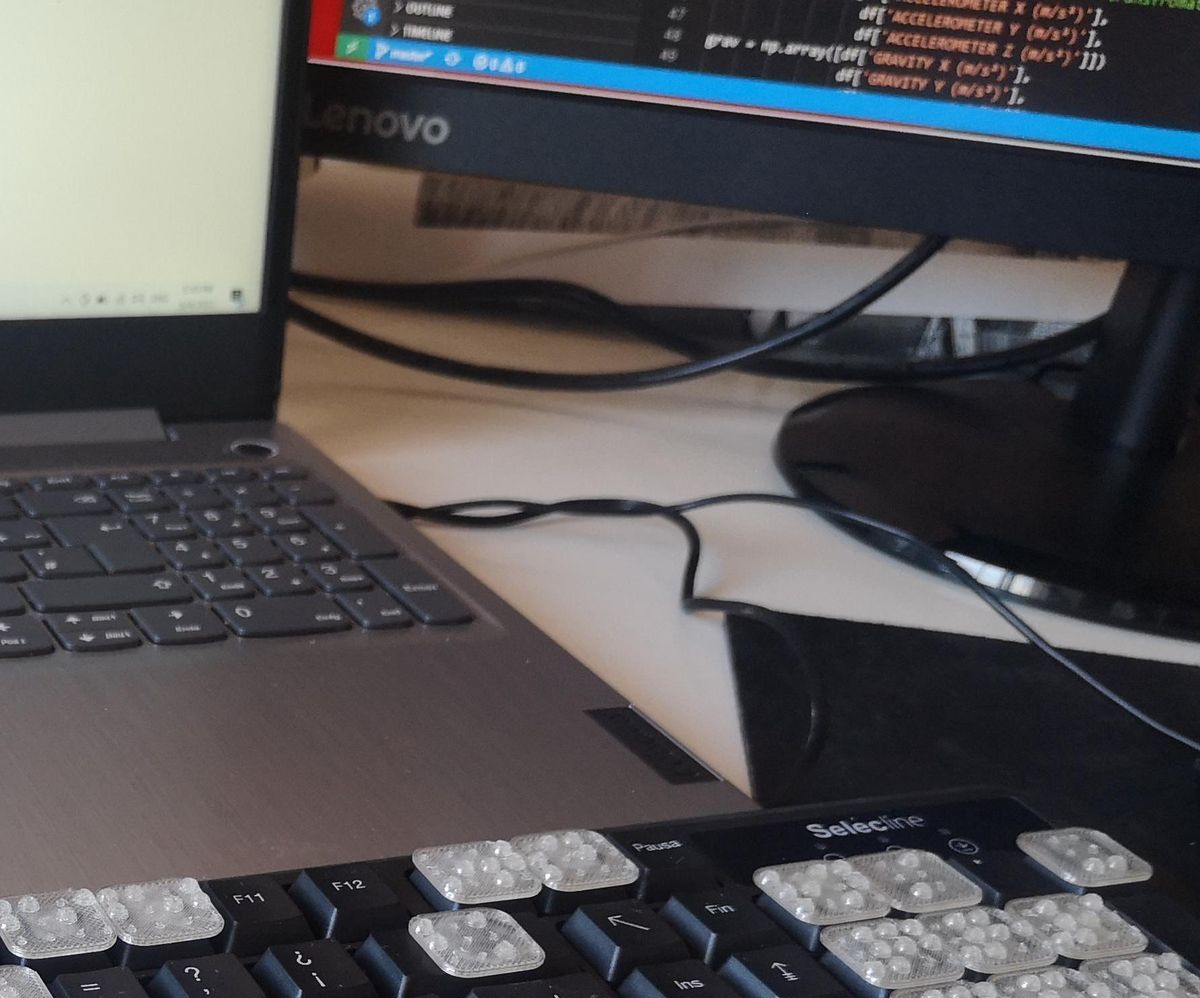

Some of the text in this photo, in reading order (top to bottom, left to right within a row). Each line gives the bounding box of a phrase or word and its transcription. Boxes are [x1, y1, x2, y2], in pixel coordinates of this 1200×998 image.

[405, 1, 455, 19] OUTLINE
[403, 23, 454, 43] TIMELINE
[1009, 23, 1020, 36] Y
[704, 33, 740, 51] grav
[939, 58, 951, 72] X
[934, 80, 946, 93] Y
[806, 815, 927, 839] Selecline
[632, 839, 683, 854] Pausa
[331, 879, 366, 892] F12
[233, 892, 265, 905] F11
[705, 902, 734, 916] Fin
[184, 966, 201, 982] ?
[673, 976, 704, 990] Ins
